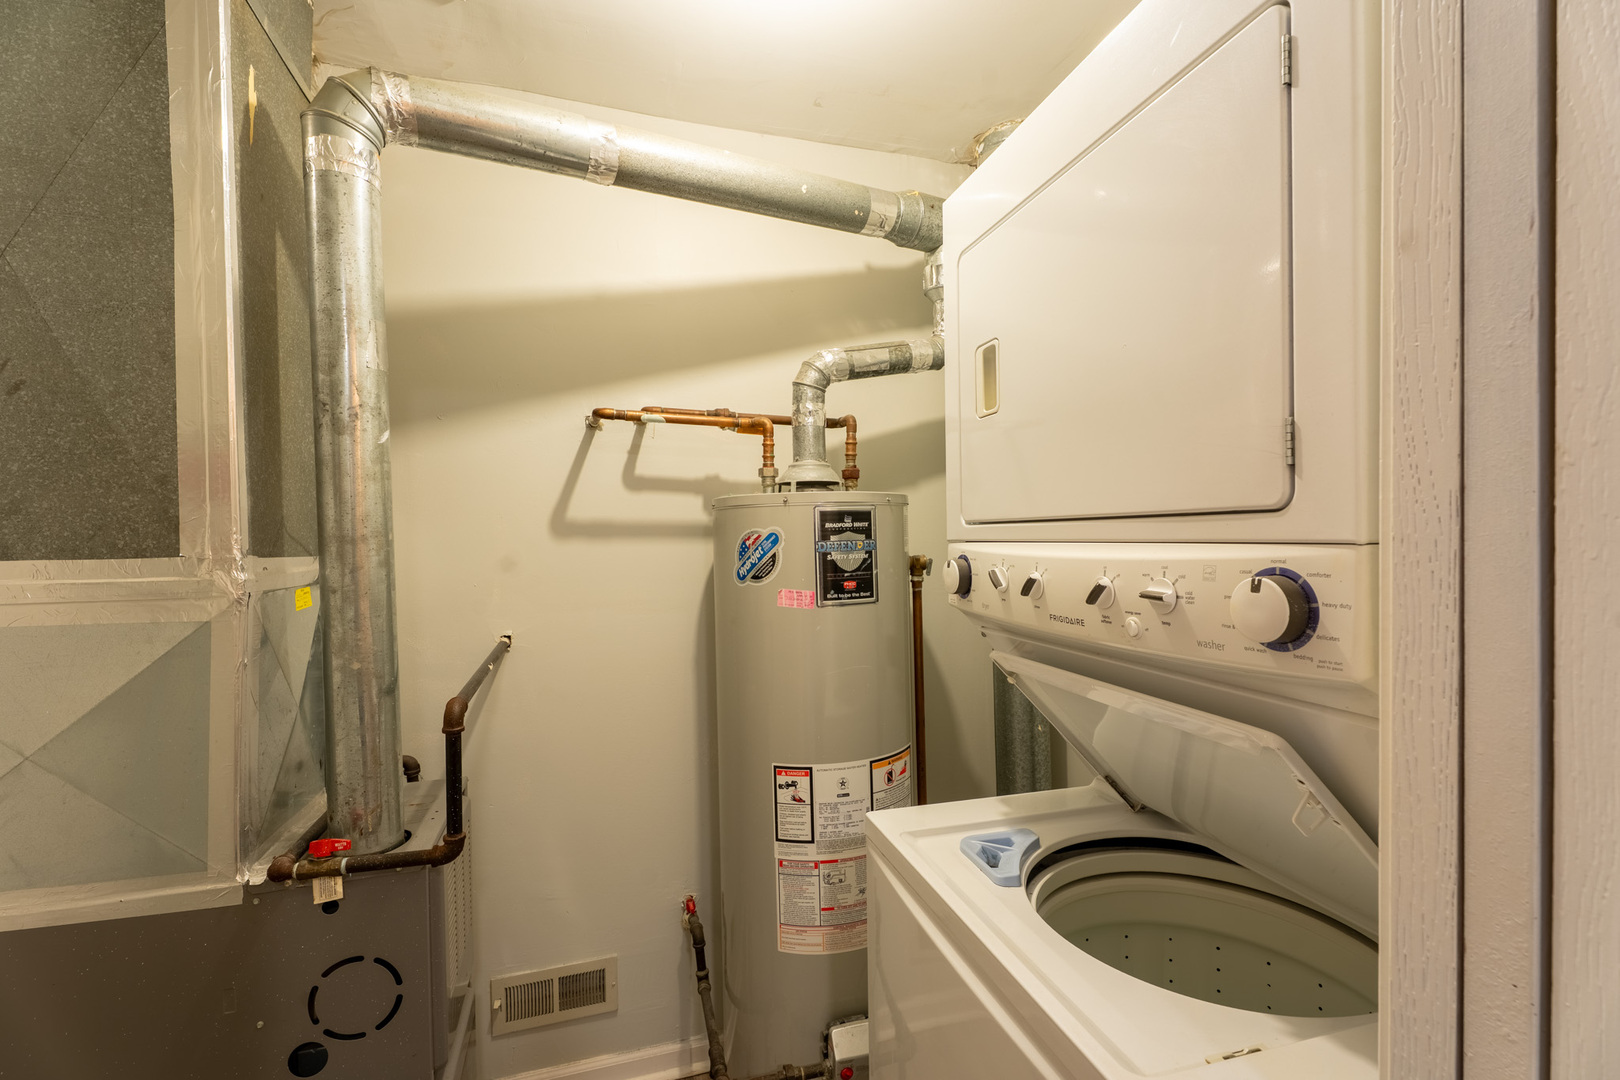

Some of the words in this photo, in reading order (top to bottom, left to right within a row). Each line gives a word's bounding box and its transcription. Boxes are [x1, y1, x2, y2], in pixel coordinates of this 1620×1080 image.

[817, 539, 876, 552] DEFENDER
[1049, 613, 1086, 627] FRIGIDAIRE
[1316, 634, 1340, 643] delicates
[1196, 639, 1225, 651] washer
[1293, 654, 1314, 662] bedding
